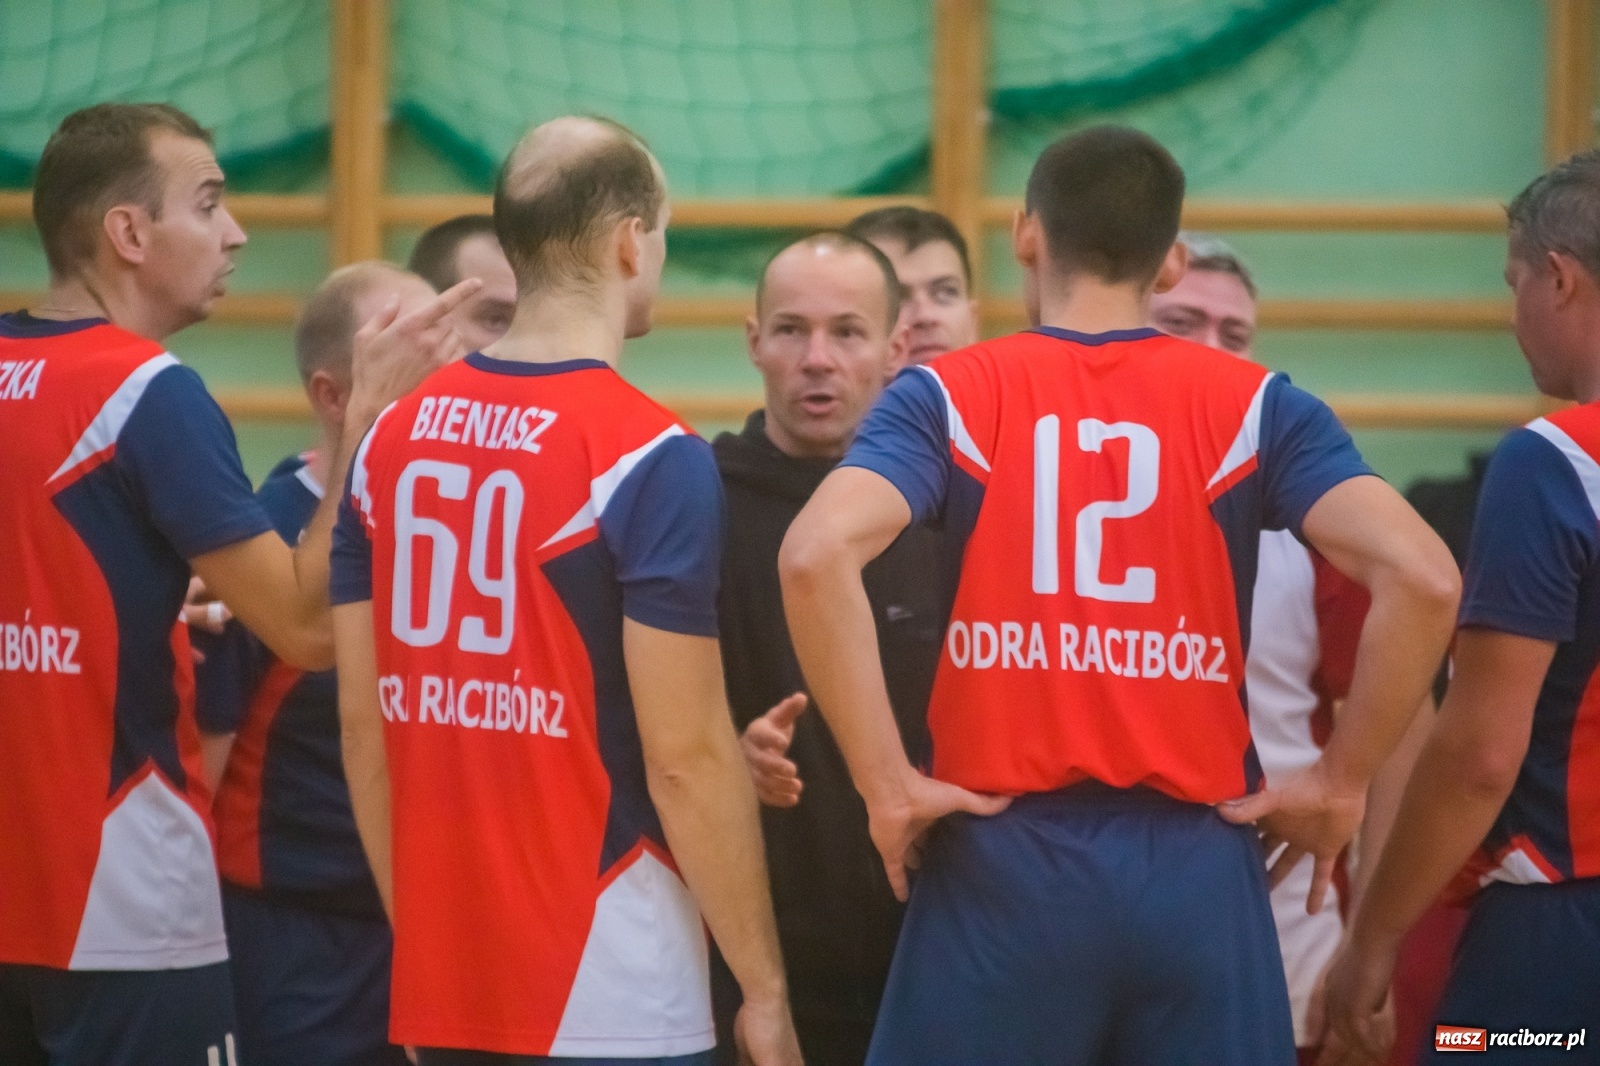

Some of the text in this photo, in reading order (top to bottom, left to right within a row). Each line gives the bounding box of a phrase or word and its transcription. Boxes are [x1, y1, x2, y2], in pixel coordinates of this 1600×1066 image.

[409, 395, 559, 455] BIENIASZ
[1031, 413, 1161, 604] 12
[391, 458, 525, 655] 69
[0, 607, 82, 674] BÓRZ
[947, 615, 1229, 683] ODRA RACIBÓRZ
[418, 668, 568, 738] RACIBÓRZ
